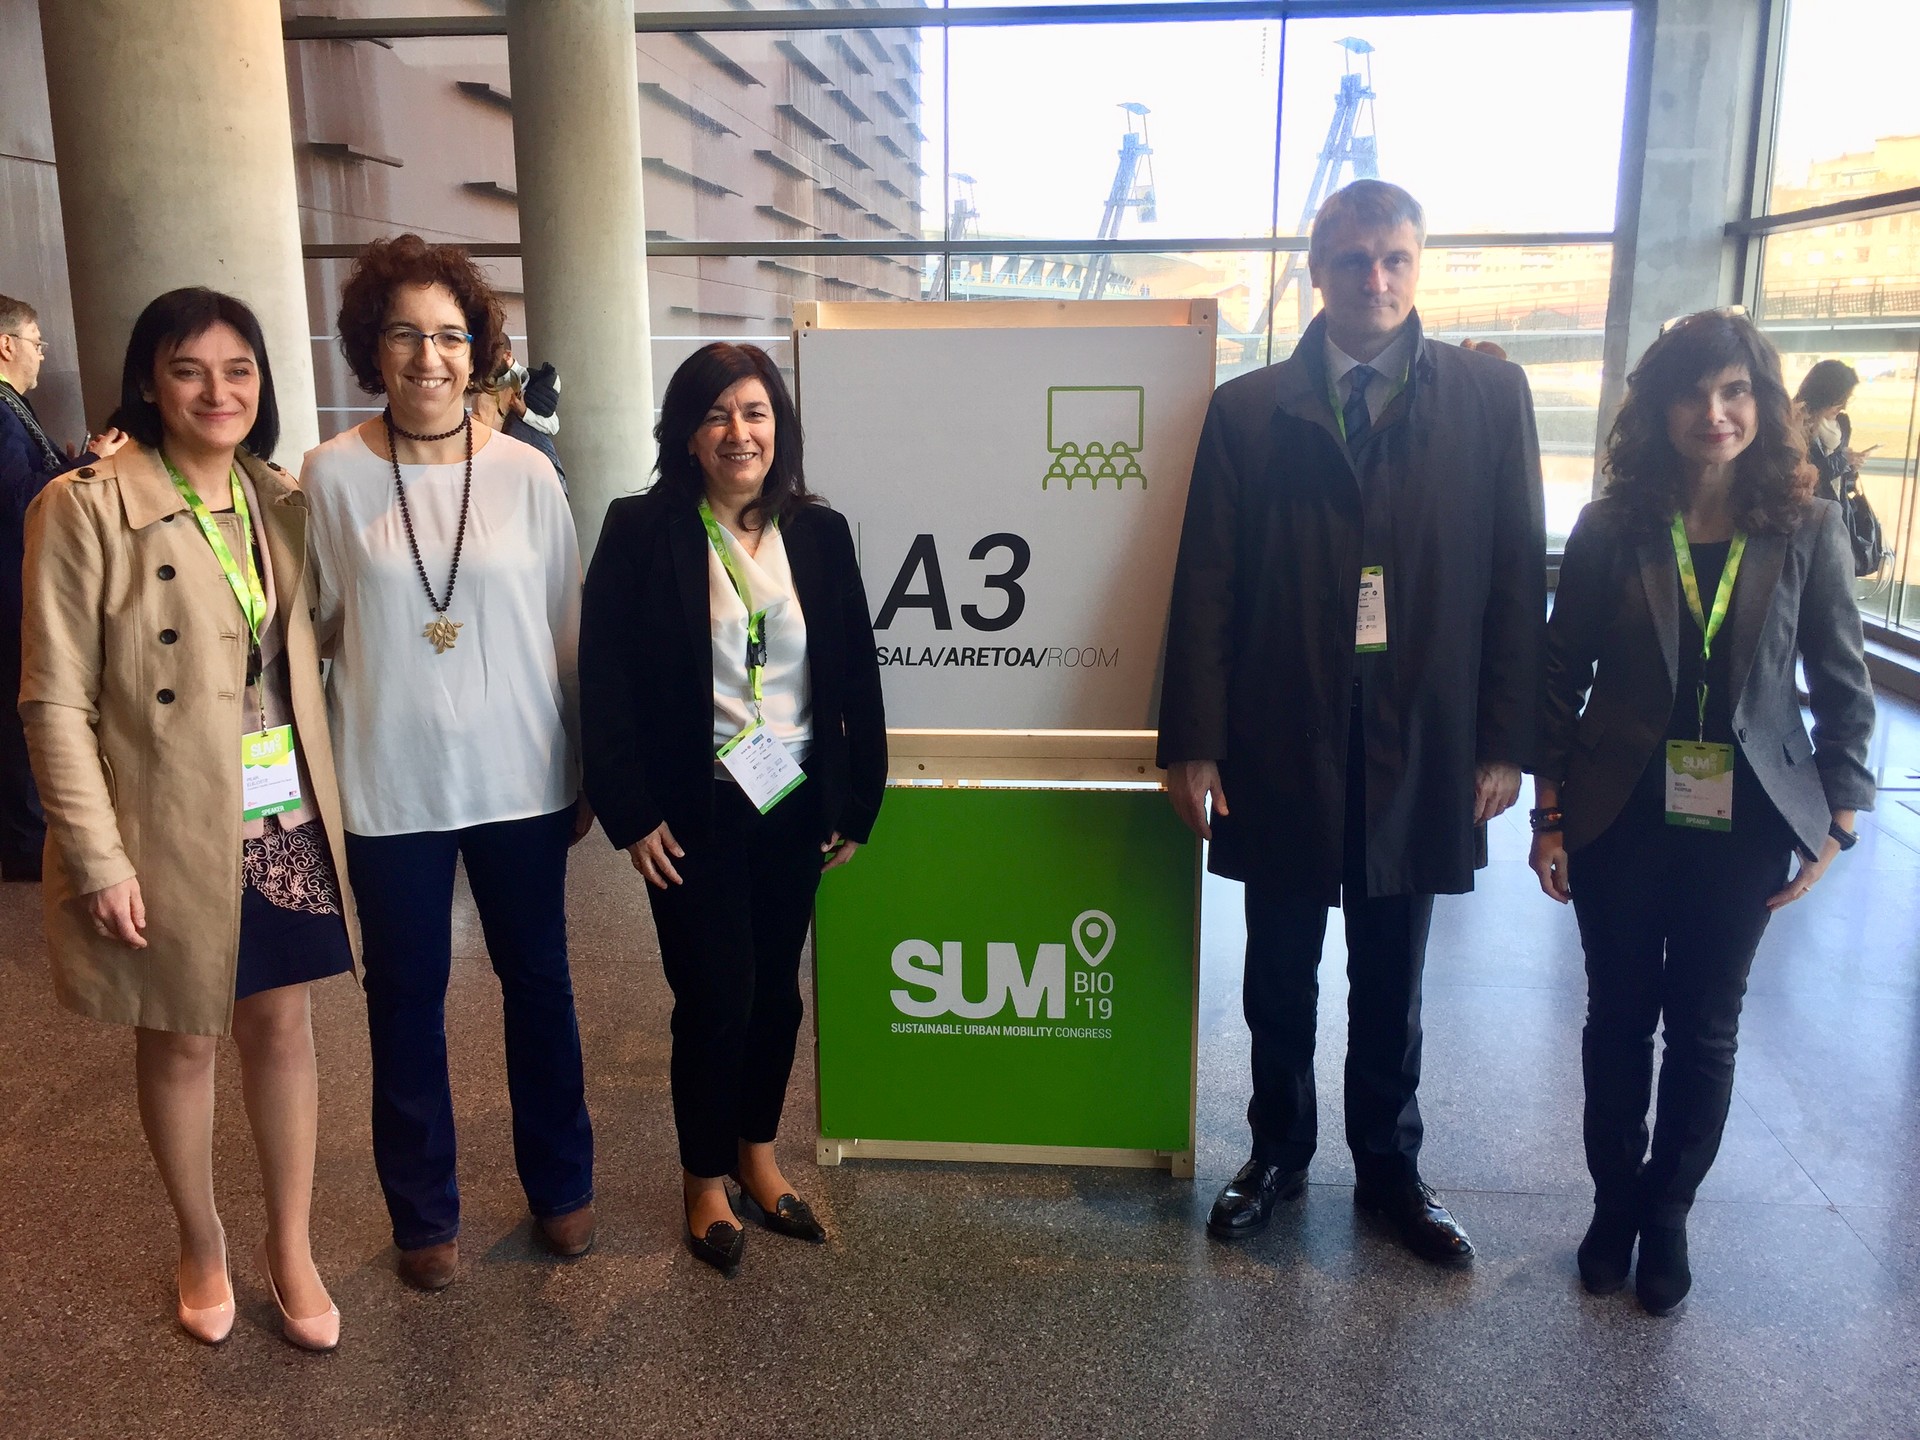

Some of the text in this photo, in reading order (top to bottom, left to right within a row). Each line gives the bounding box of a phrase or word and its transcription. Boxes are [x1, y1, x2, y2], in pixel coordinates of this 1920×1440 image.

[873, 533, 1031, 632] A3
[261, 804, 285, 817] SPEAKER
[1686, 816, 1710, 825] SPEAKER
[890, 939, 1066, 1019] SUM
[1074, 971, 1114, 994] BIO
[891, 1022, 1112, 1039] SUSTAINABLE URBAN MOBILITY CONGRESS
